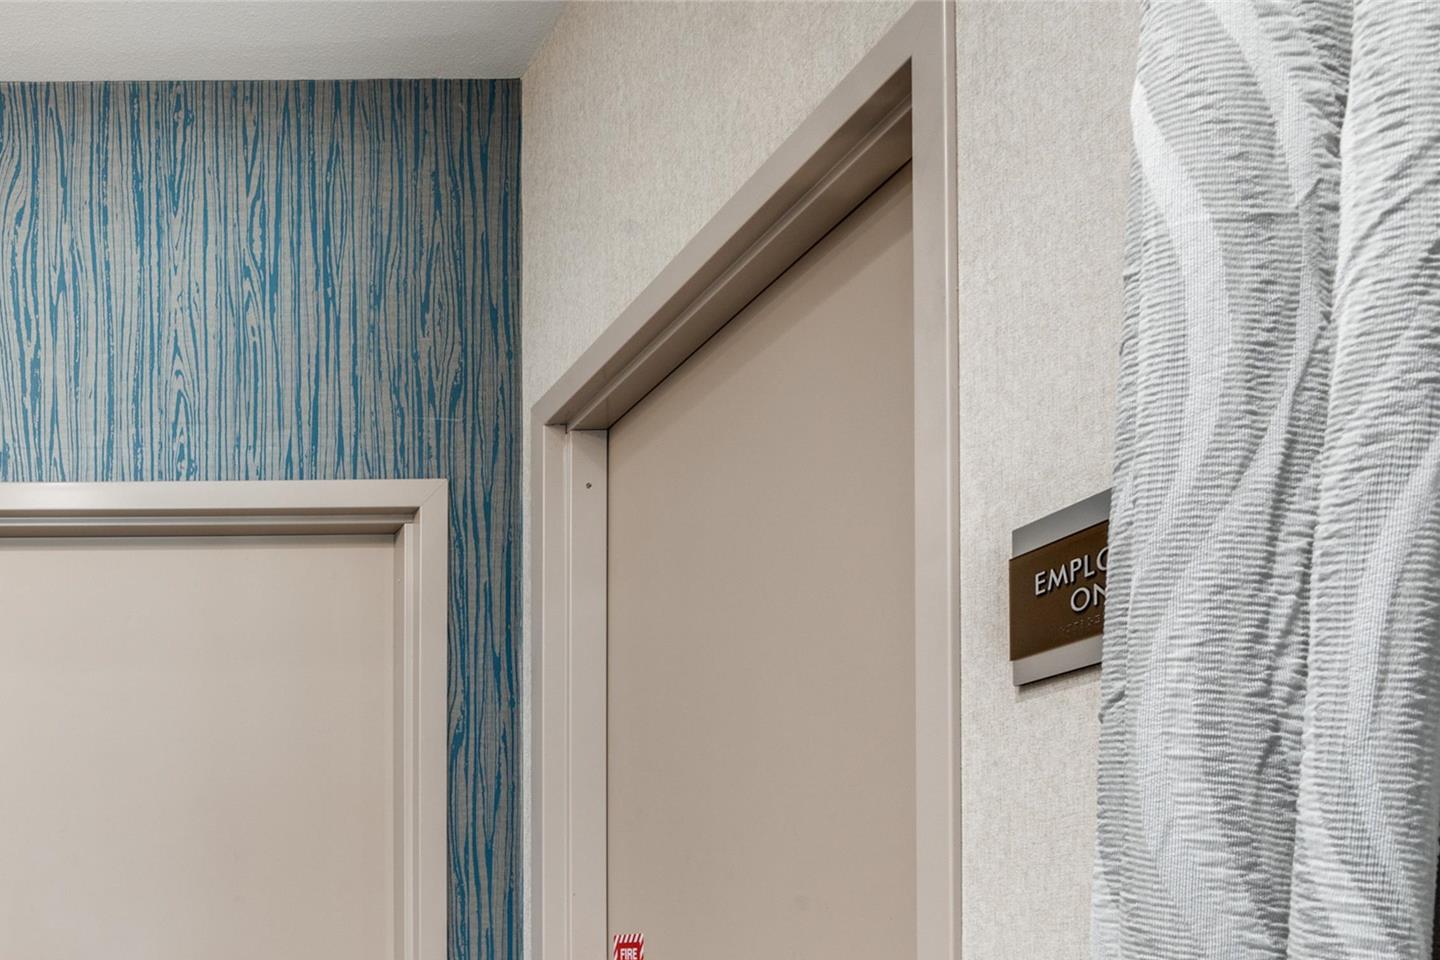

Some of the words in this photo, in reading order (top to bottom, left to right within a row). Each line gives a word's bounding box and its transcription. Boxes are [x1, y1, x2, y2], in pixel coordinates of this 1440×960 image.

[1034, 546, 1109, 596] EMPLO
[1071, 583, 1107, 612] ON
[620, 948, 638, 960] FIRE
